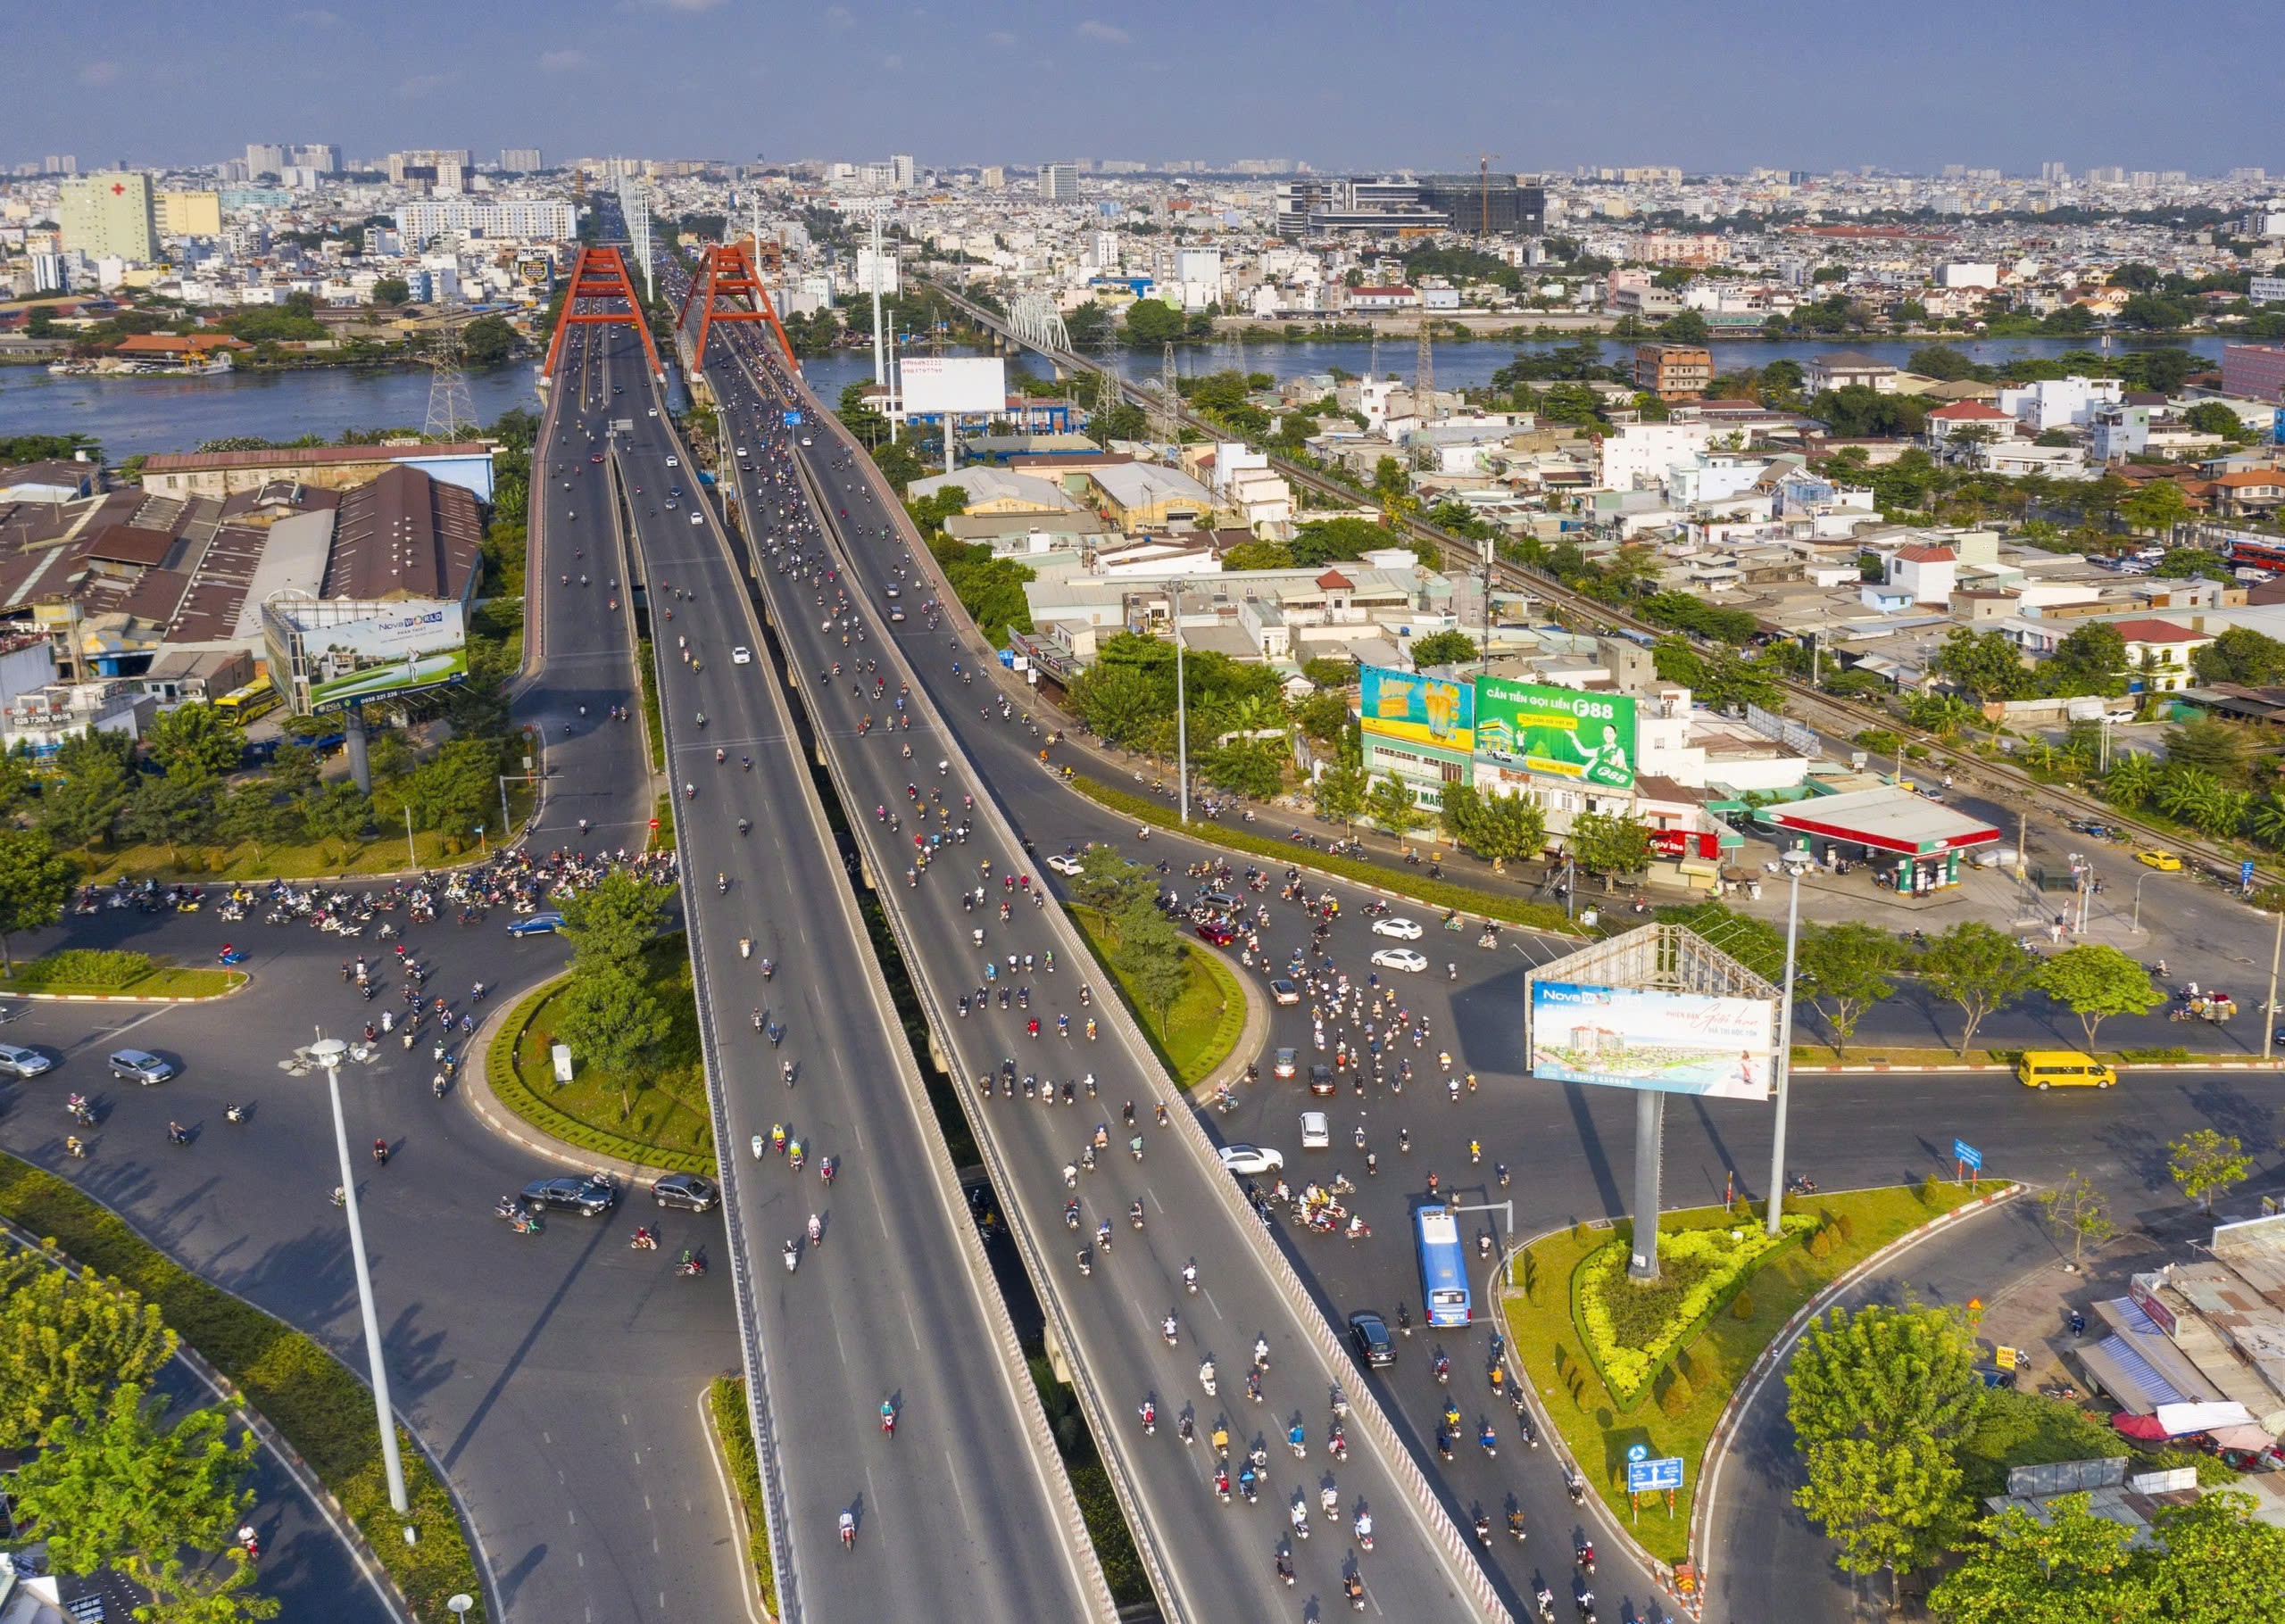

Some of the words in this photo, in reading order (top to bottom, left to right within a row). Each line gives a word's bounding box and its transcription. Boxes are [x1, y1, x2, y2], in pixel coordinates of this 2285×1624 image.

[1486, 686, 1507, 700] CẦN
[1508, 691, 1527, 703] TIỀN
[1530, 696, 1549, 708] GỌI
[1550, 697, 1570, 710] LIỀN
[1573, 699, 1613, 719] F88
[1421, 791, 1443, 807] MAR
